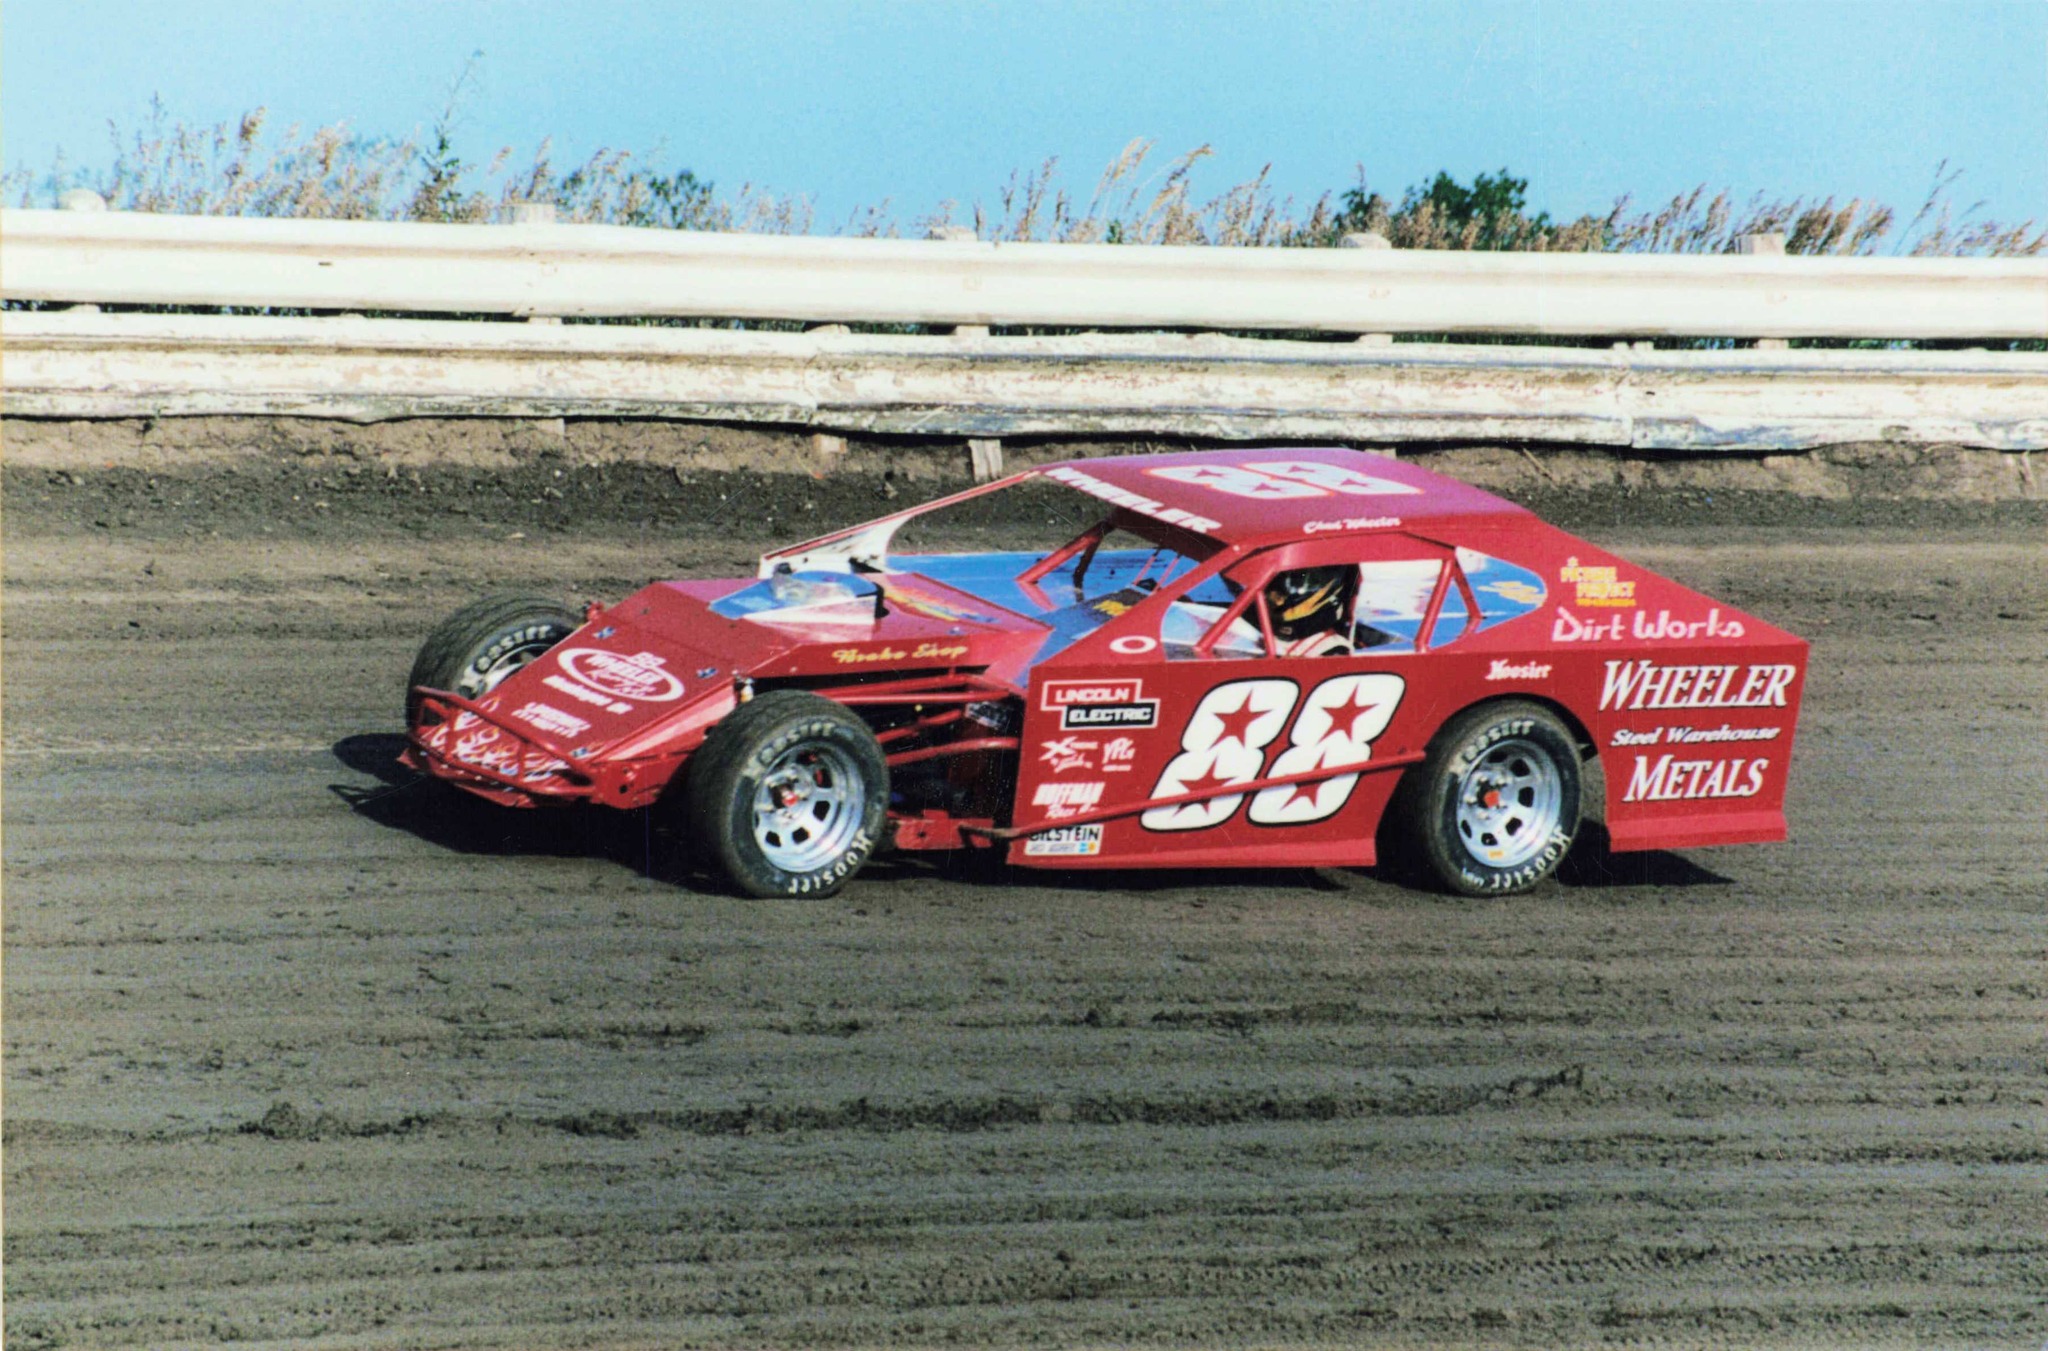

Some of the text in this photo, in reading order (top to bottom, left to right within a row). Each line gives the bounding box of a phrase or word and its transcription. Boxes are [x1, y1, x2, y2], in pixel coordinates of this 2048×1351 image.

[1142, 460, 1426, 500] 88
[1045, 467, 1223, 533] WHEELER
[1552, 607, 1746, 642] Dirt Works
[1485, 659, 1552, 681] Hoosier
[1598, 659, 1797, 712] WHEELER
[1055, 687, 1131, 704] LINCOLN
[1068, 706, 1152, 724] ELECTRIC
[1139, 671, 1407, 833] 88
[1610, 724, 1781, 747] Steel Warehouse
[1622, 754, 1770, 802] METALS
